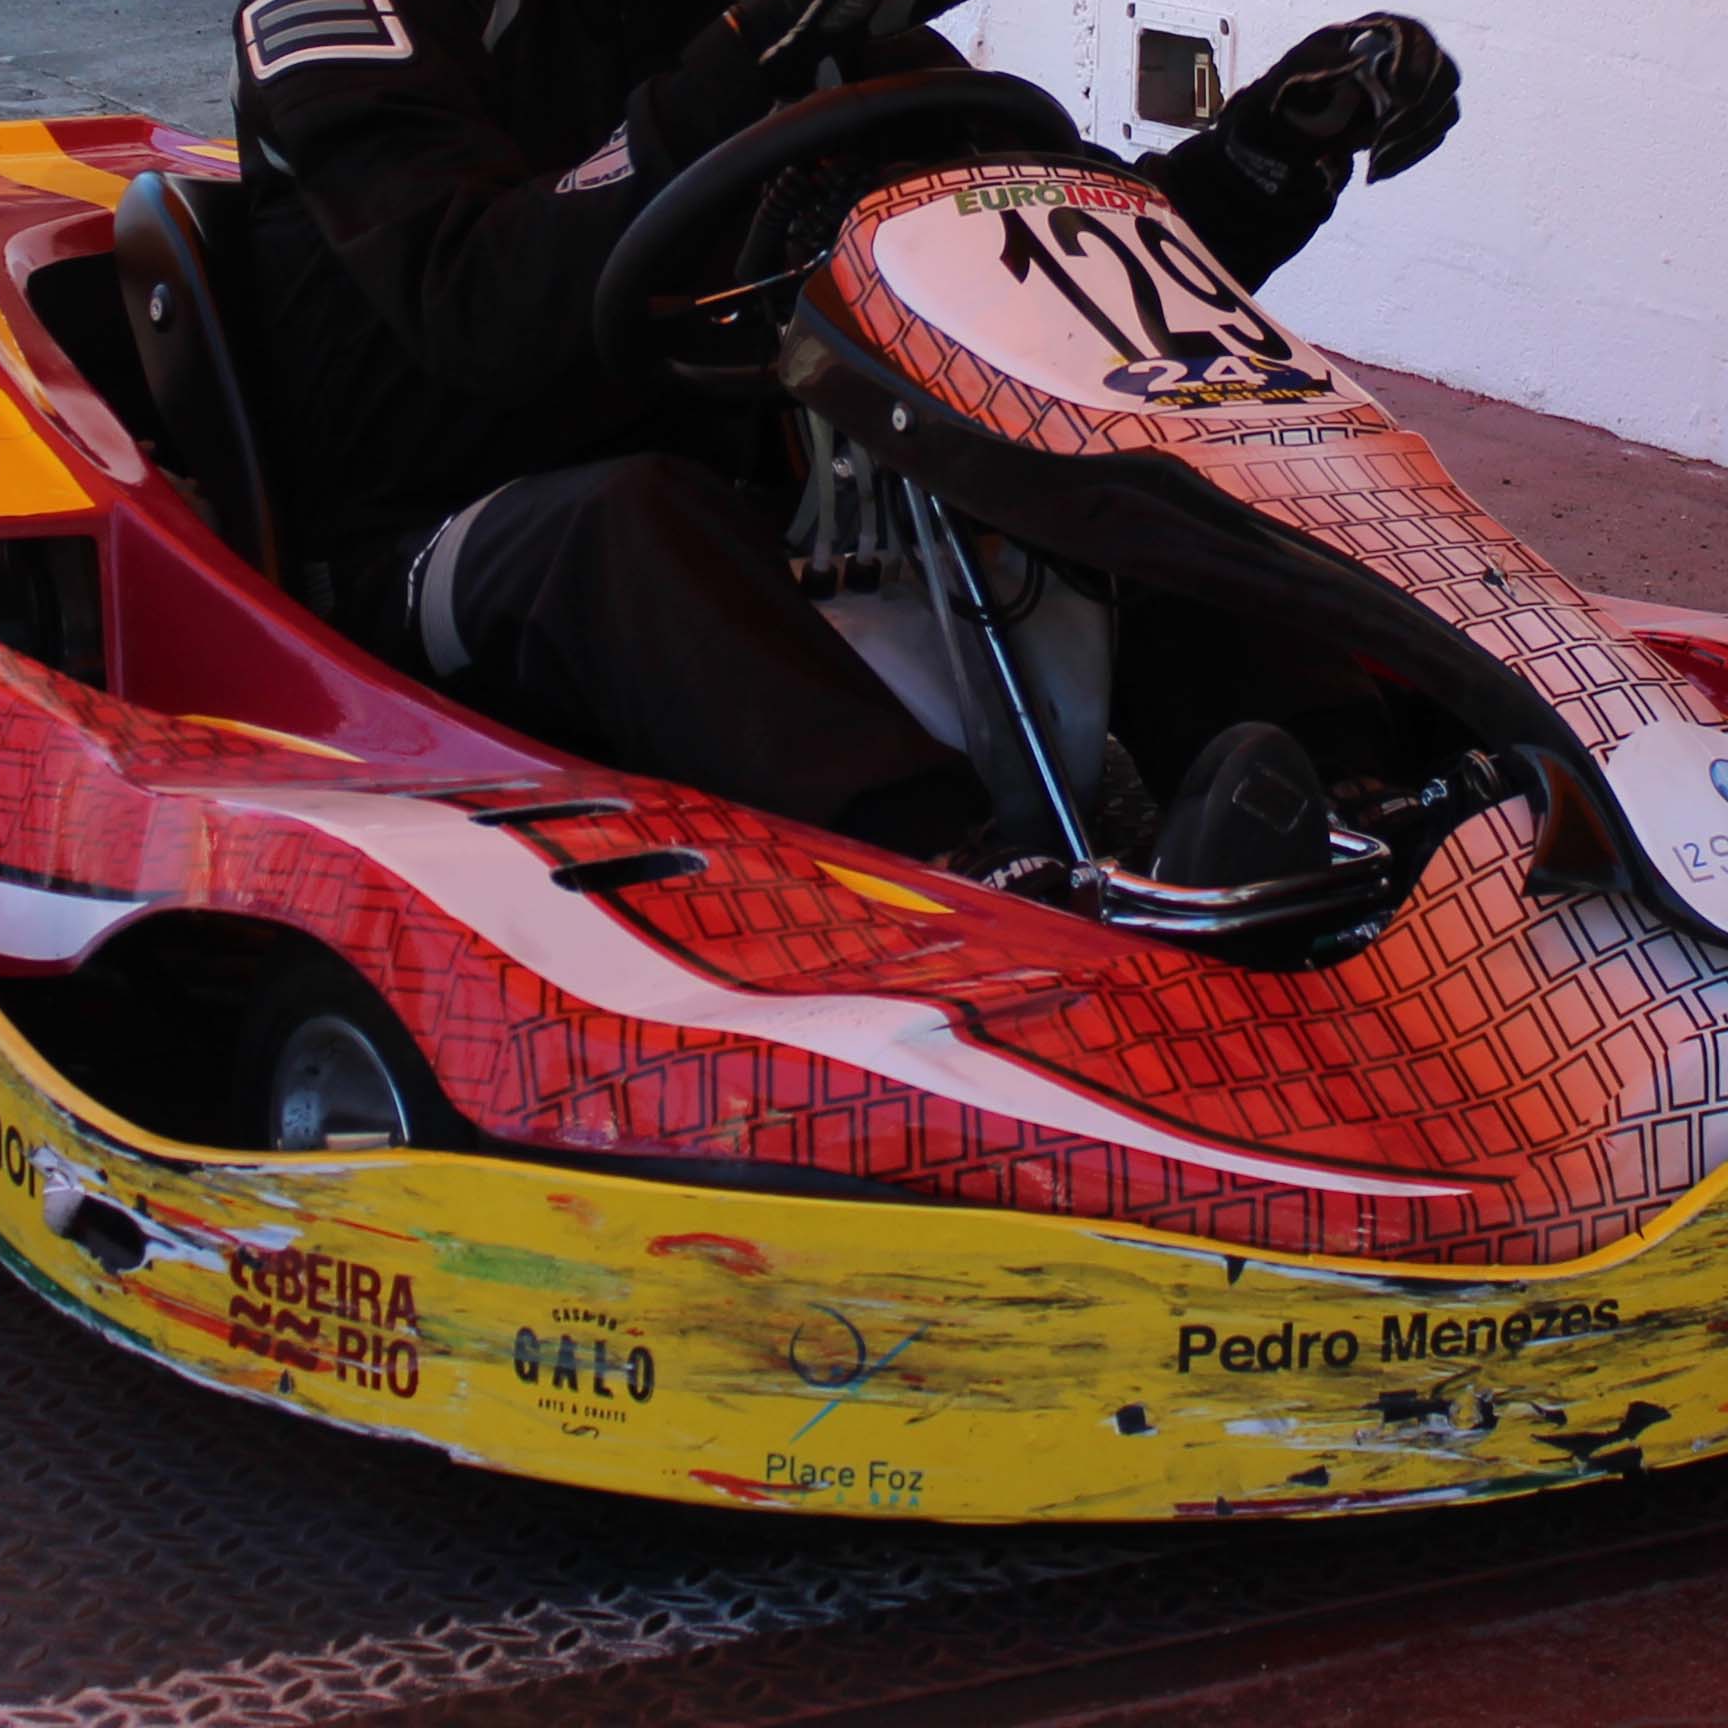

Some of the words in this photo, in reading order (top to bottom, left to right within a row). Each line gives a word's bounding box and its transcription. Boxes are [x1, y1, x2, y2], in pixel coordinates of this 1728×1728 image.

[954, 184, 1147, 216] EUROINDY
[999, 205, 1293, 363] 129
[1127, 355, 1269, 393] 24
[1199, 388, 1325, 404] Batalha
[336, 1325, 420, 1400] RIO
[513, 1325, 655, 1404] GALO
[1176, 1321, 1360, 1374] Pedro
[1381, 1297, 1622, 1364] Menezes
[765, 1451, 856, 1488] Place
[868, 1459, 925, 1493] Foz
